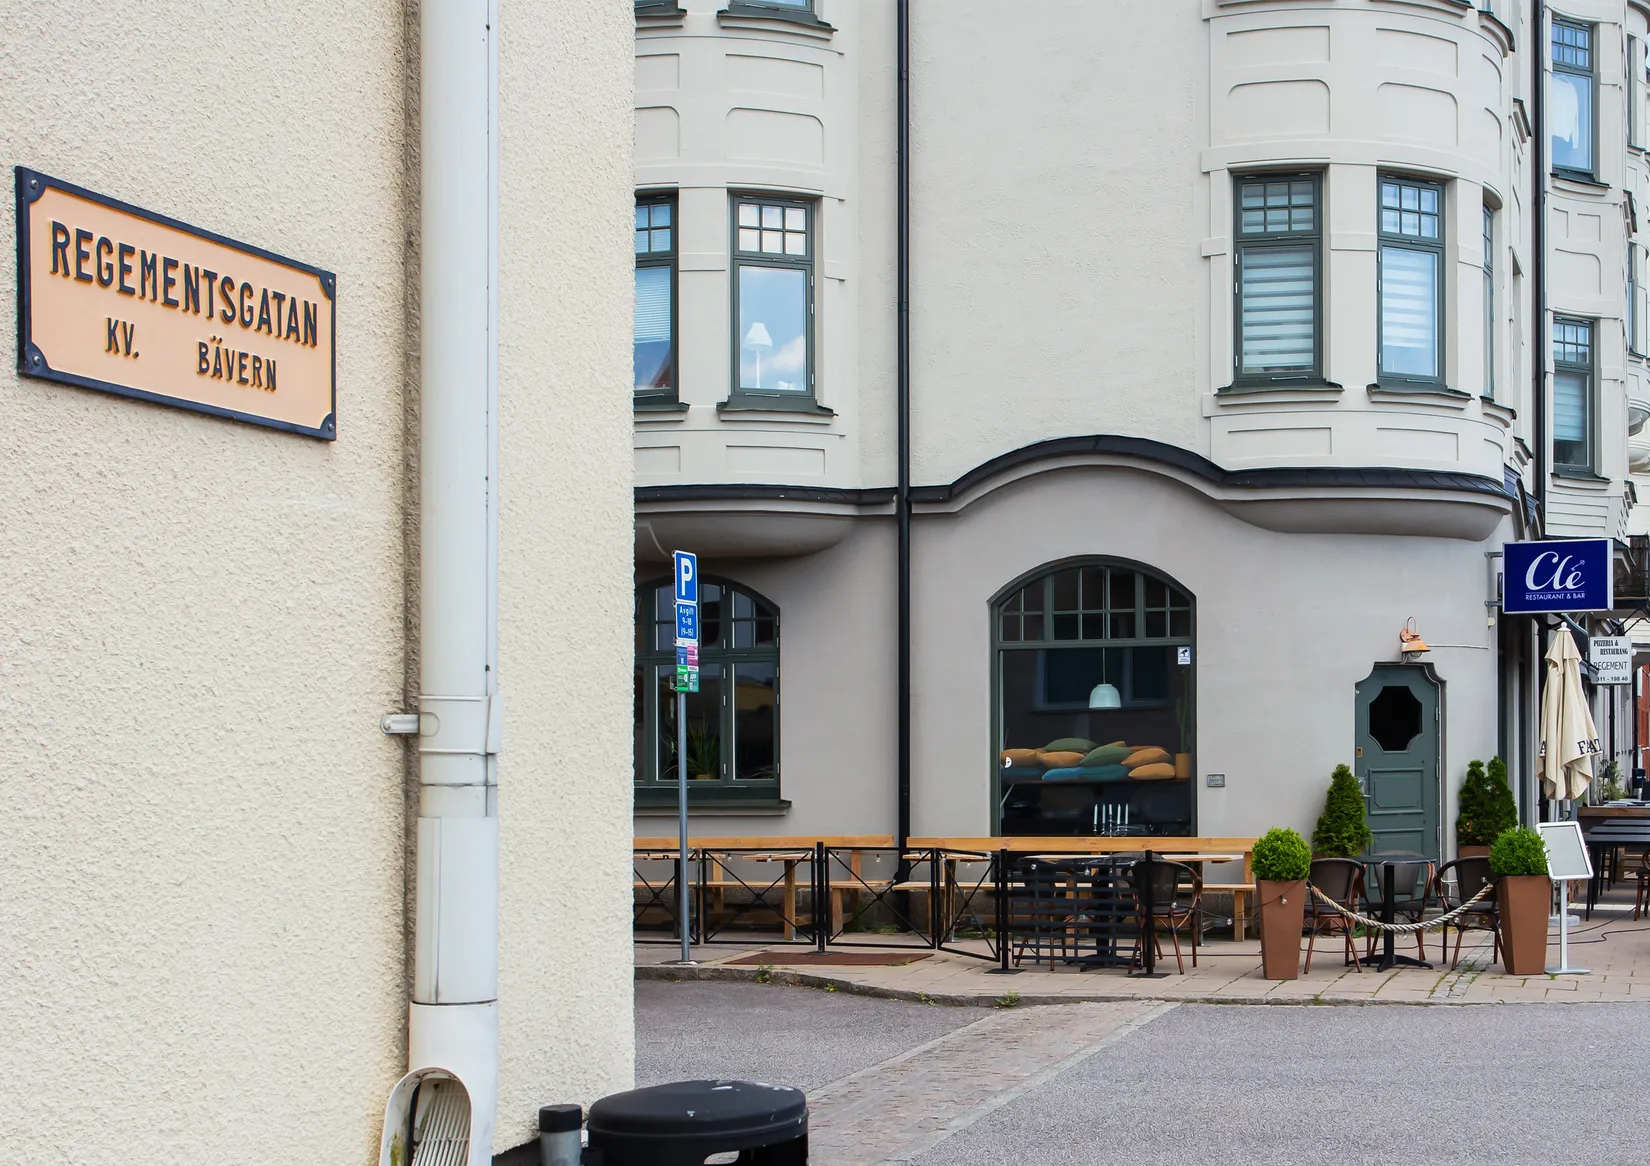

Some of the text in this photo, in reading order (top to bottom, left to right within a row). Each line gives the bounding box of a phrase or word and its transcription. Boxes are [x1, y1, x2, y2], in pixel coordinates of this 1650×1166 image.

[50, 220, 318, 347] REGEMENTSGATAN
[105, 316, 277, 392] KV. BÄVERN
[680, 557, 692, 596] P
[1526, 593, 1565, 601] RESTAURANT
[680, 606, 694, 616] Avgift
[1593, 639, 1613, 647] PIZZERIA
